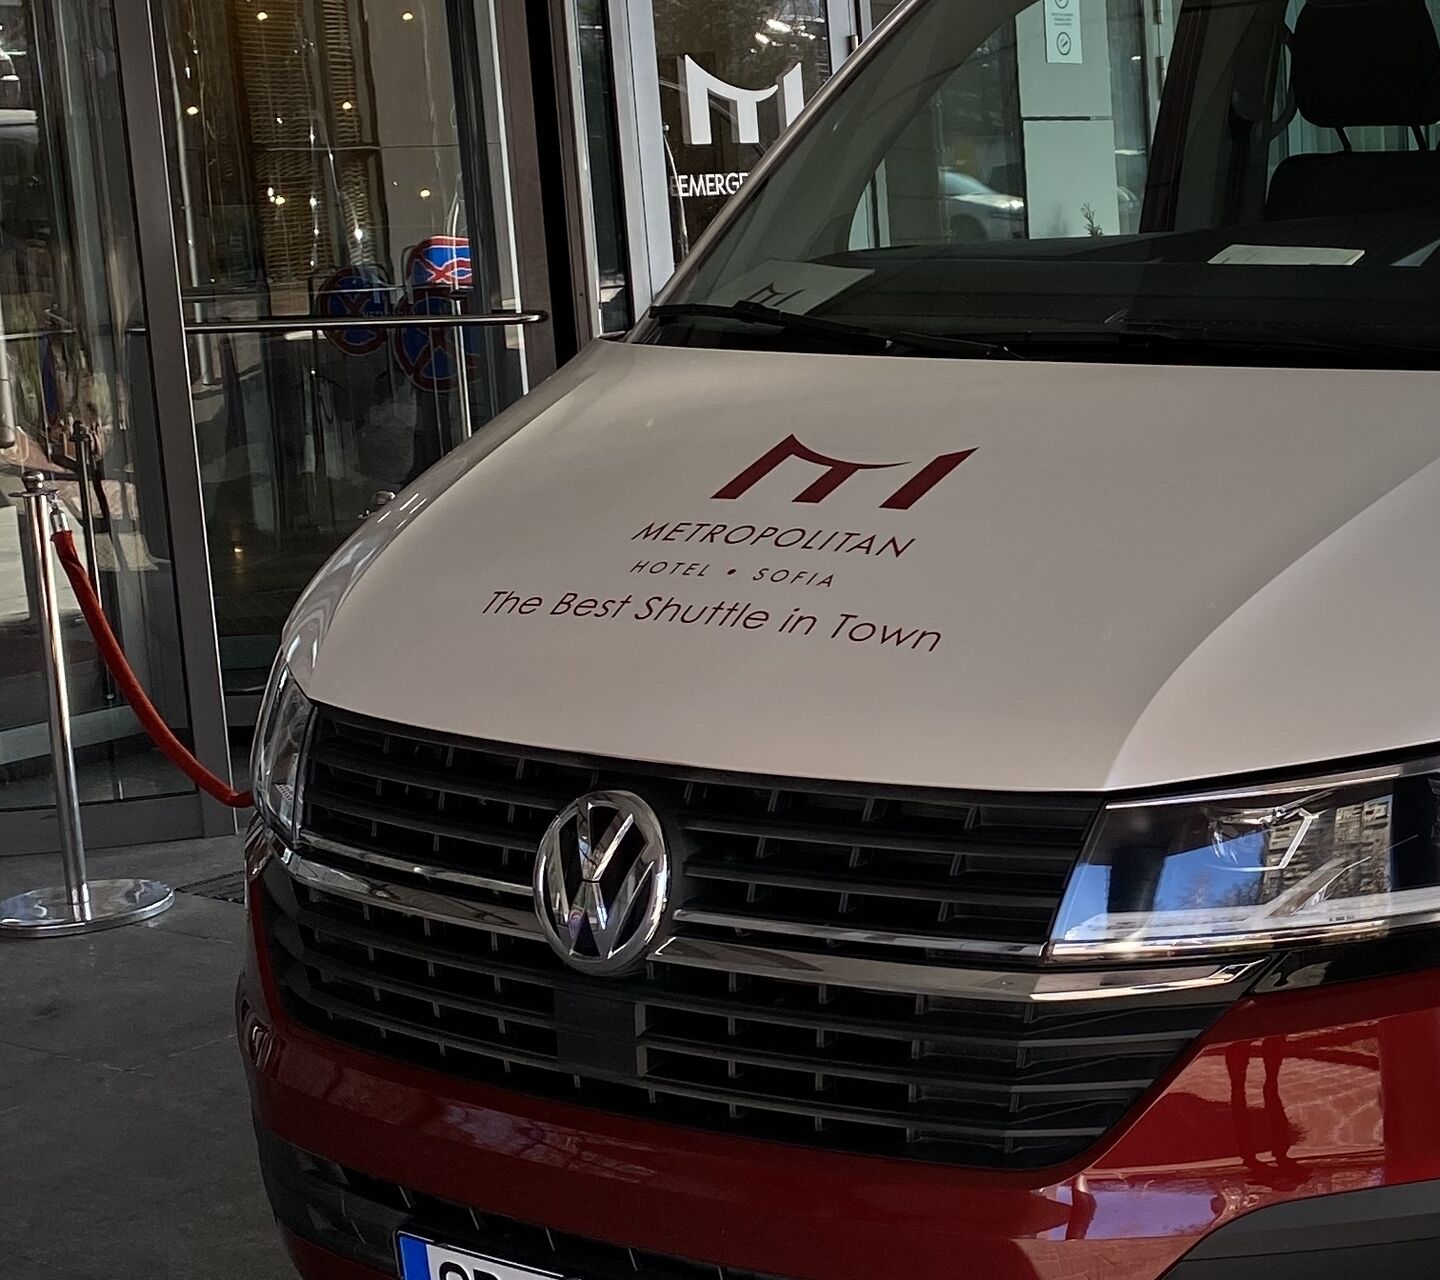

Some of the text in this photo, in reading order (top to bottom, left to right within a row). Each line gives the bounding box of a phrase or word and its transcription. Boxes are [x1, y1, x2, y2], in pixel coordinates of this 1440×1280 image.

[629, 521, 917, 559] METROPOLITAN
[628, 559, 837, 588] HOTEL SOFIA
[480, 589, 944, 653] The Best Shuttle in Town
